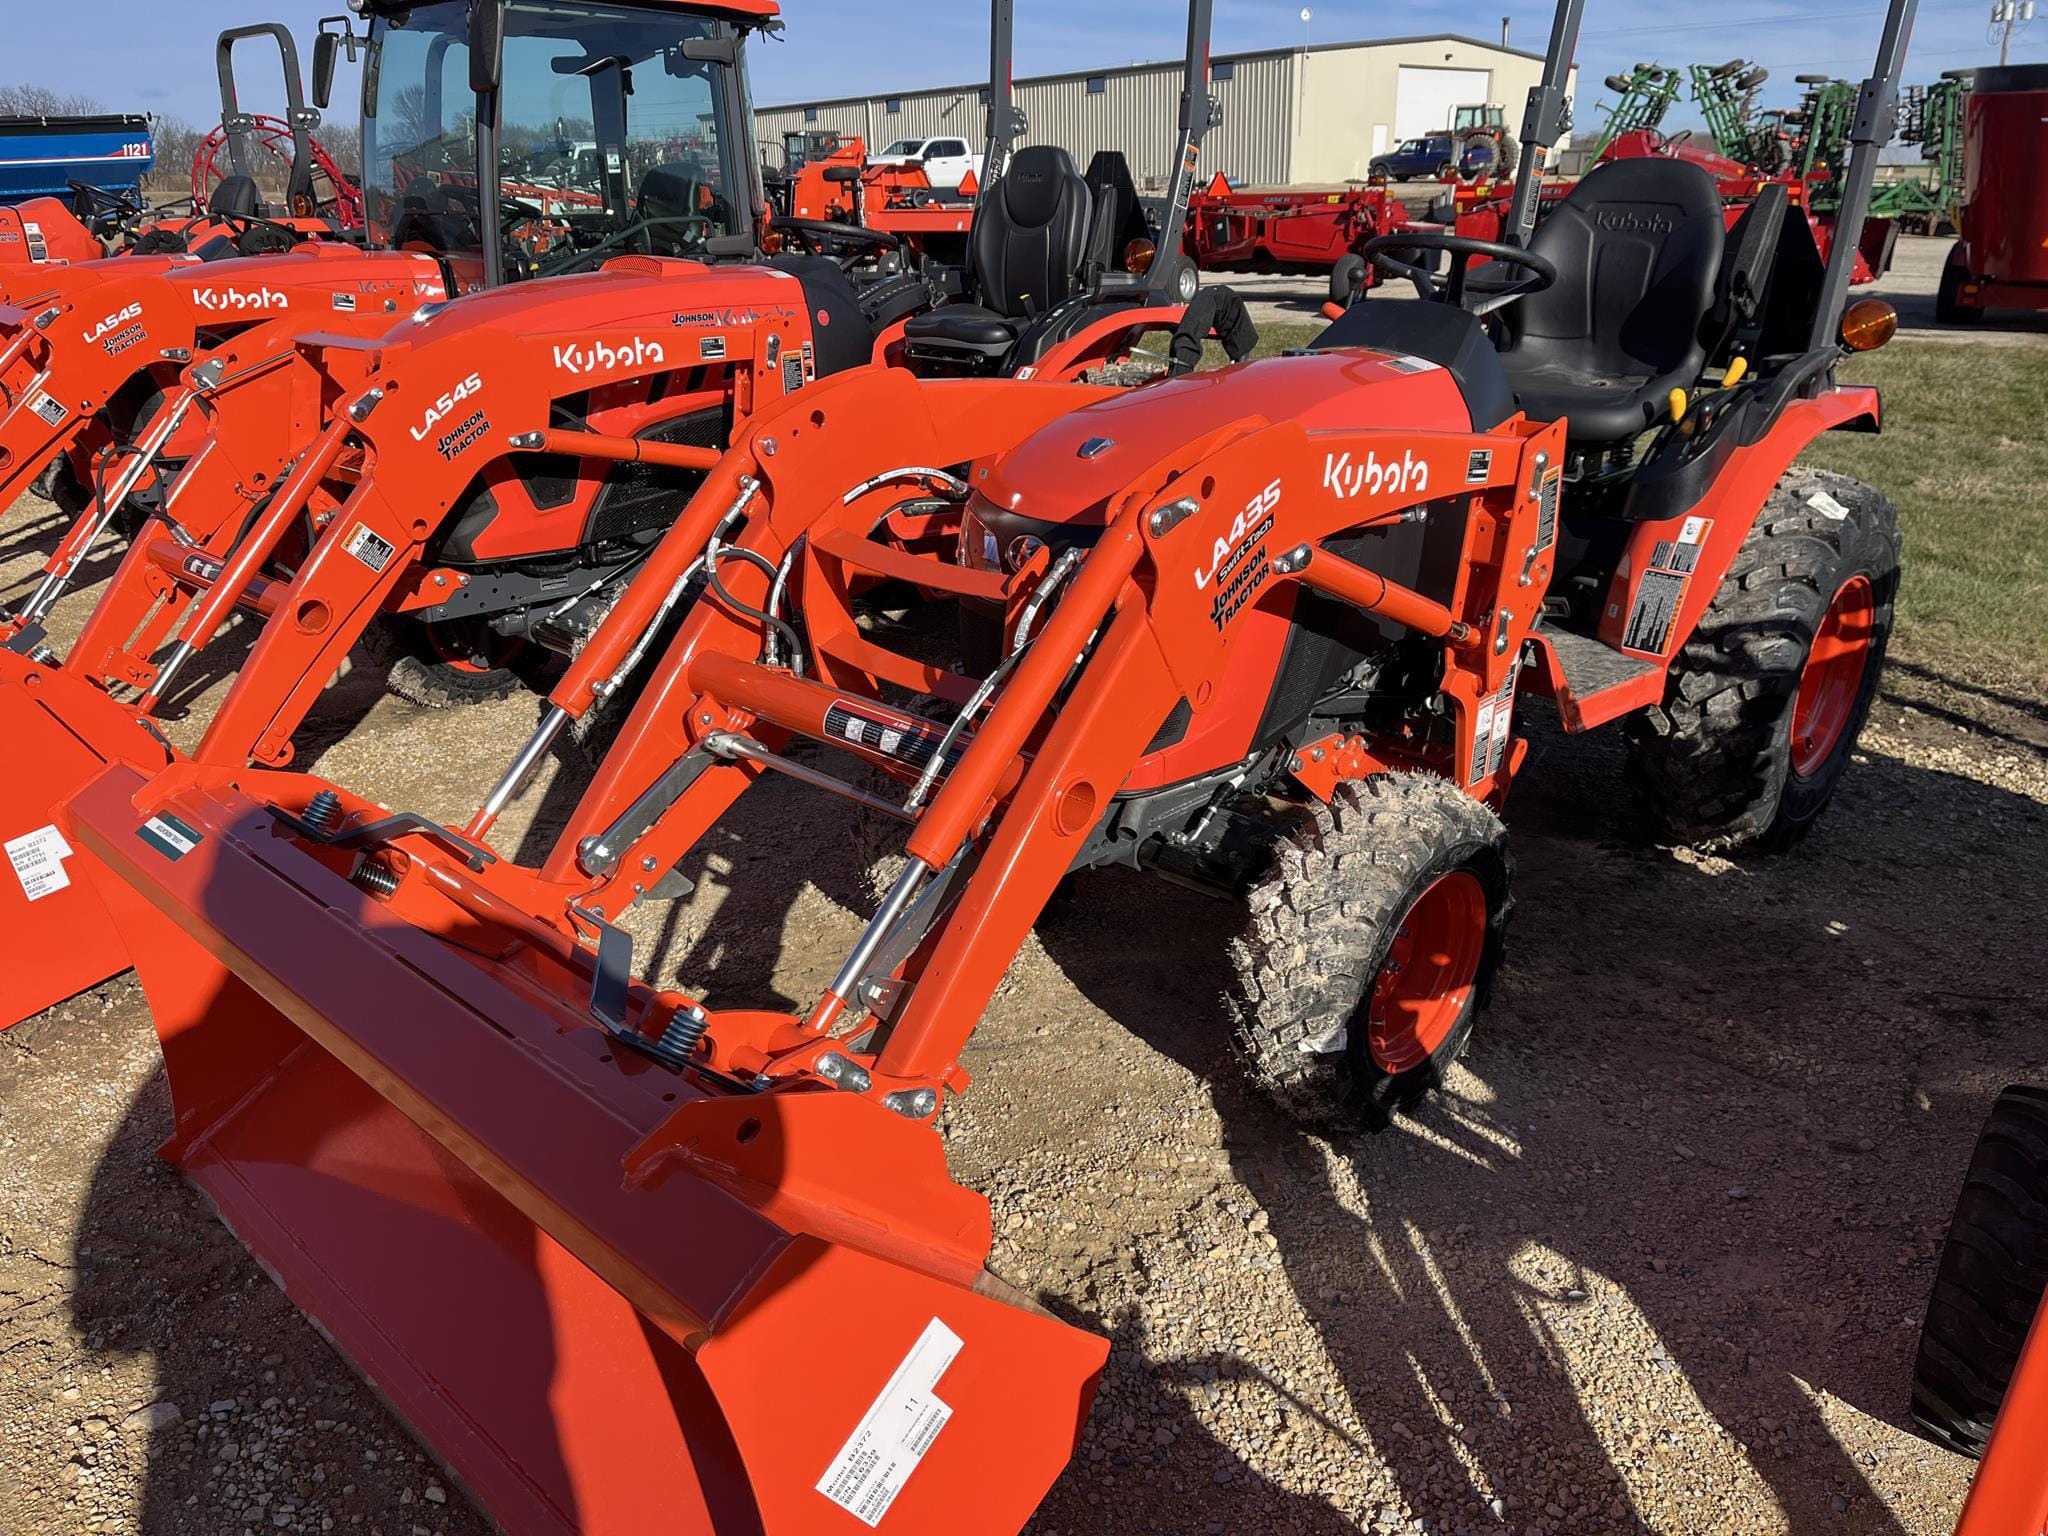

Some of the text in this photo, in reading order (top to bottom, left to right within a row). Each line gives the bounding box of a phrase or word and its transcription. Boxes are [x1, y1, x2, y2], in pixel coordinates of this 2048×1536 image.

[122, 144, 146, 156] 1121
[1595, 211, 1673, 234] Kubota
[192, 286, 289, 310] Kubota
[671, 313, 714, 324] JOHNSON
[82, 301, 143, 344] LA545
[102, 322, 142, 350] JOHNSON
[106, 331, 147, 357] TRACTOR
[553, 336, 665, 374] Kubota
[409, 372, 483, 442] LA545
[437, 410, 485, 453] JOHNSON
[442, 421, 491, 462] TRACTOR
[1323, 448, 1429, 499] Kubota
[1194, 477, 1281, 590] LA435
[1210, 544, 1267, 620] JOHNSON
[1213, 562, 1270, 633] TRACTOR
[826, 1466, 848, 1494] Model
[848, 1430, 872, 1462] B2372
[854, 1449, 877, 1481] E6339
